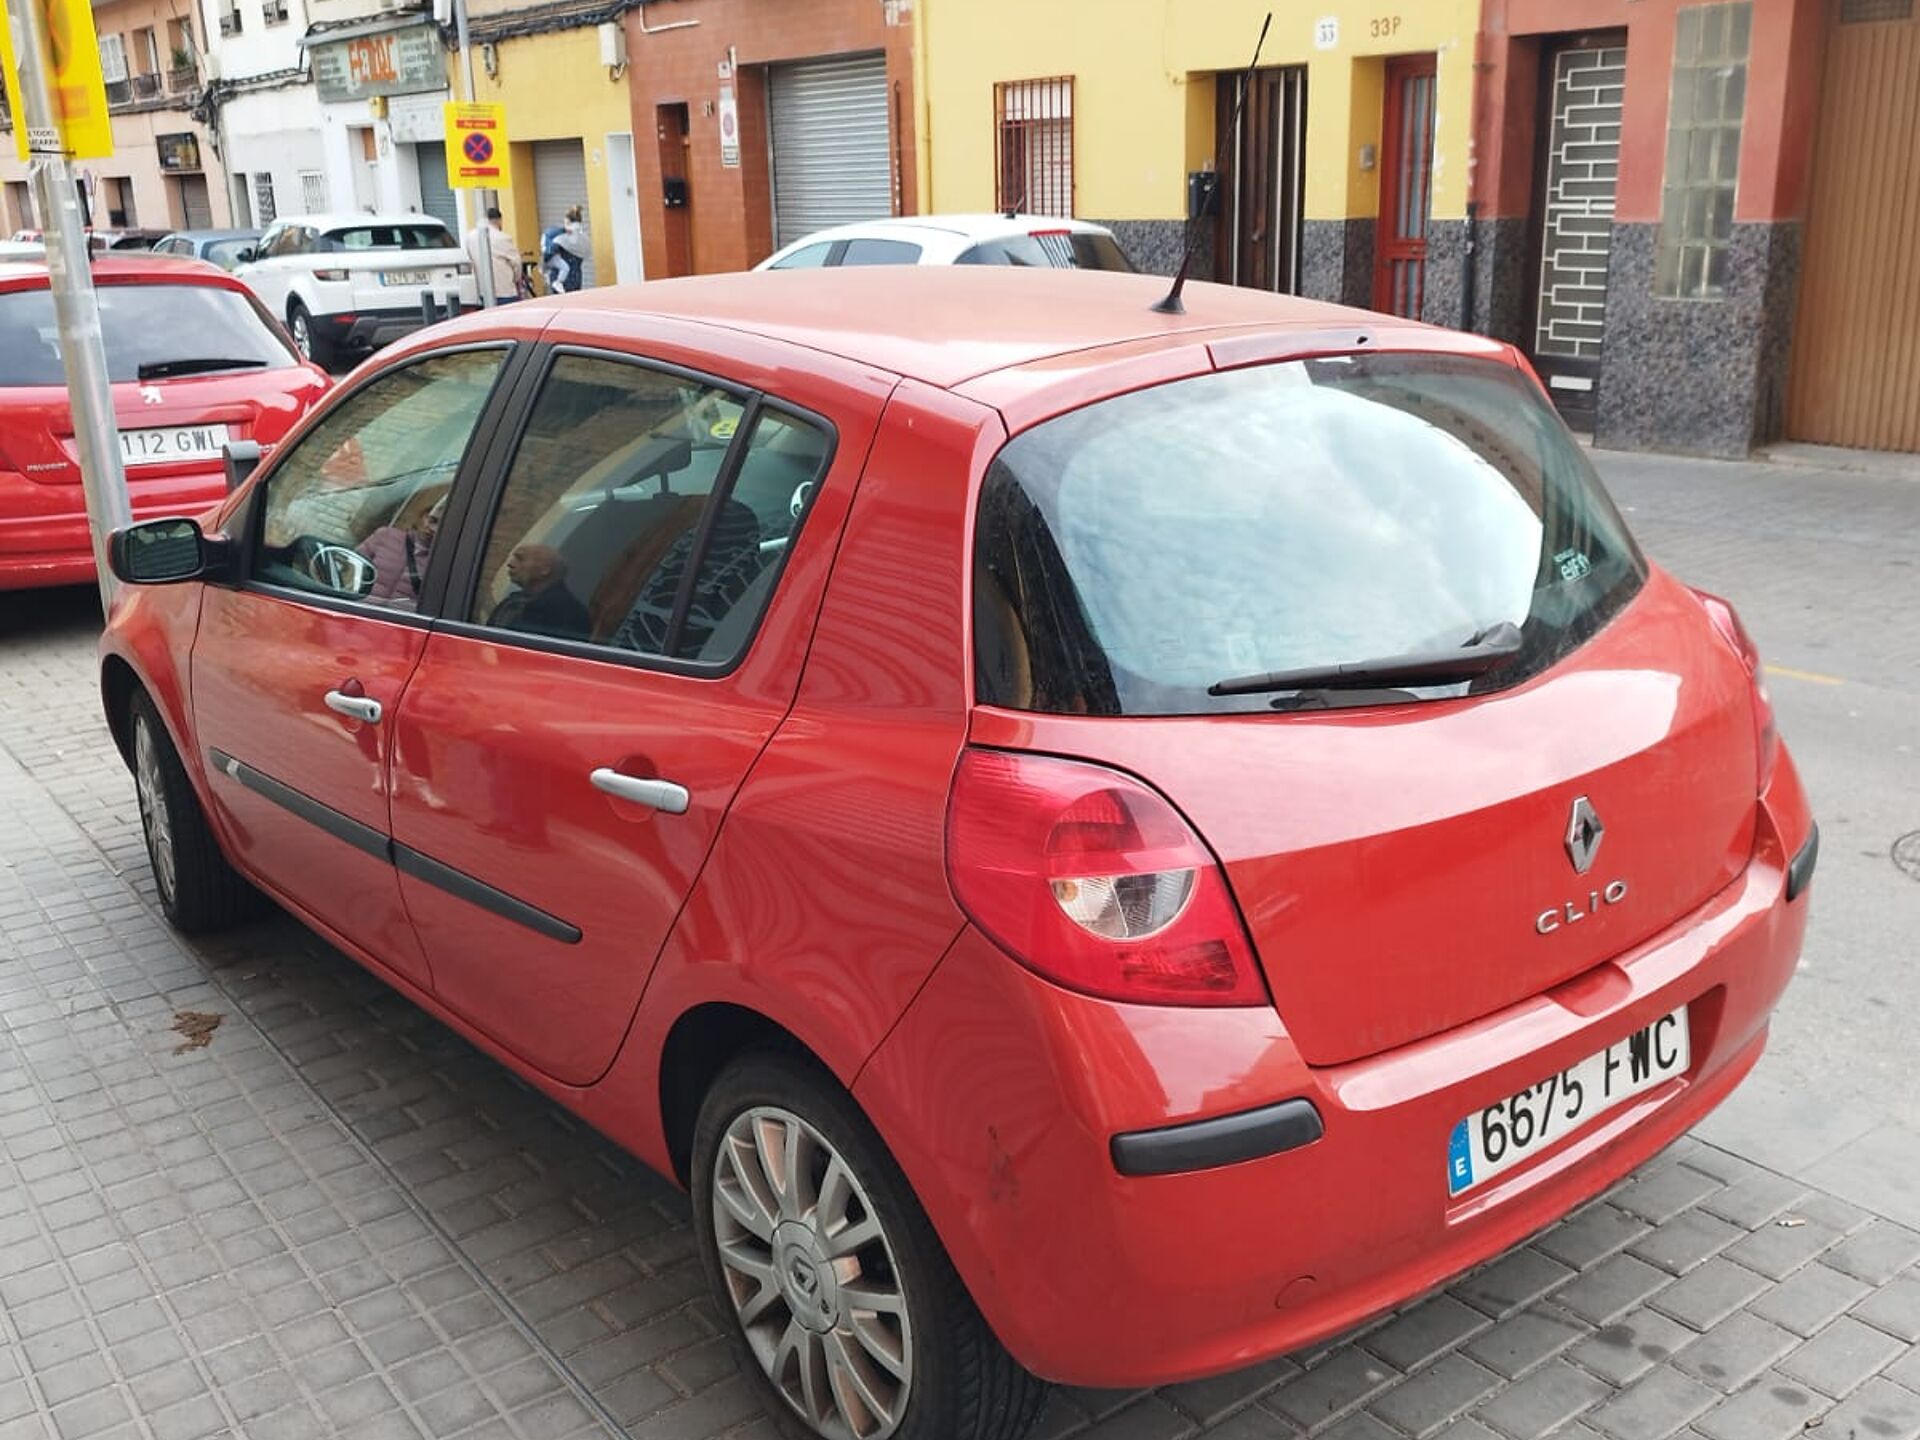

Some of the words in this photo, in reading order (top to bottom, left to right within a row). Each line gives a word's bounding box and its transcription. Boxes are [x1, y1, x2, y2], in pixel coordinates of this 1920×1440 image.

[1370, 15, 1402, 38] 33P
[121, 432, 167, 455] 112
[176, 429, 223, 452] GWL
[1535, 880, 1628, 935] CLIO
[1481, 1070, 1584, 1163] 6675
[1604, 1013, 1679, 1098] FWC
[1454, 1156, 1468, 1176] E
